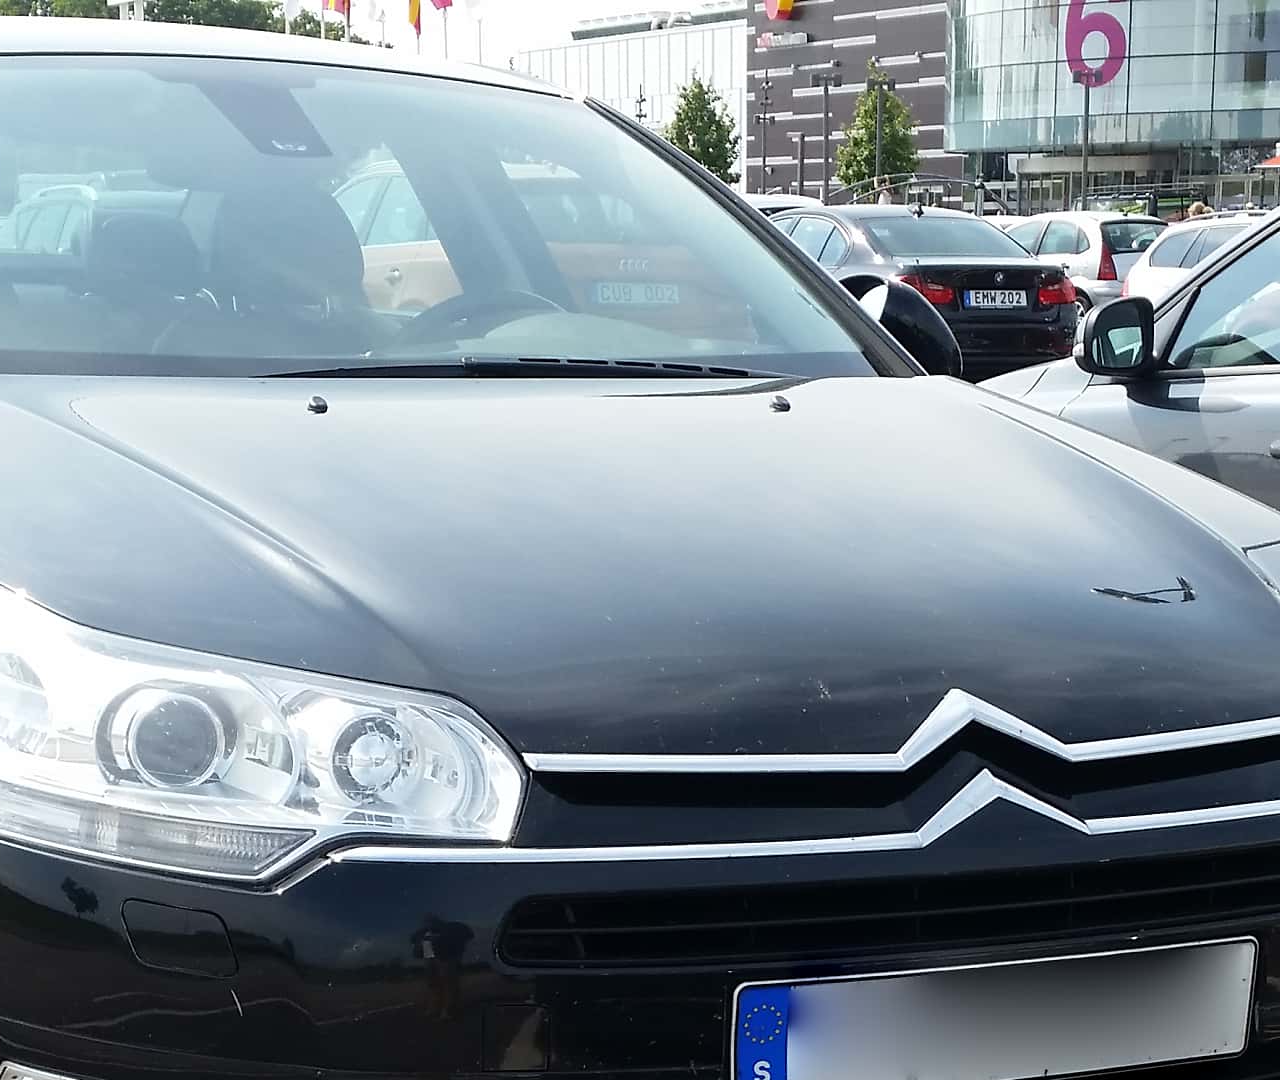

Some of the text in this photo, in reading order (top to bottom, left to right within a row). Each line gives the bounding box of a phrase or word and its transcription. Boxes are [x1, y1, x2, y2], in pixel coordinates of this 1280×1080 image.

[1065, 0, 1127, 88] 6
[974, 291, 1022, 304] EMW 202
